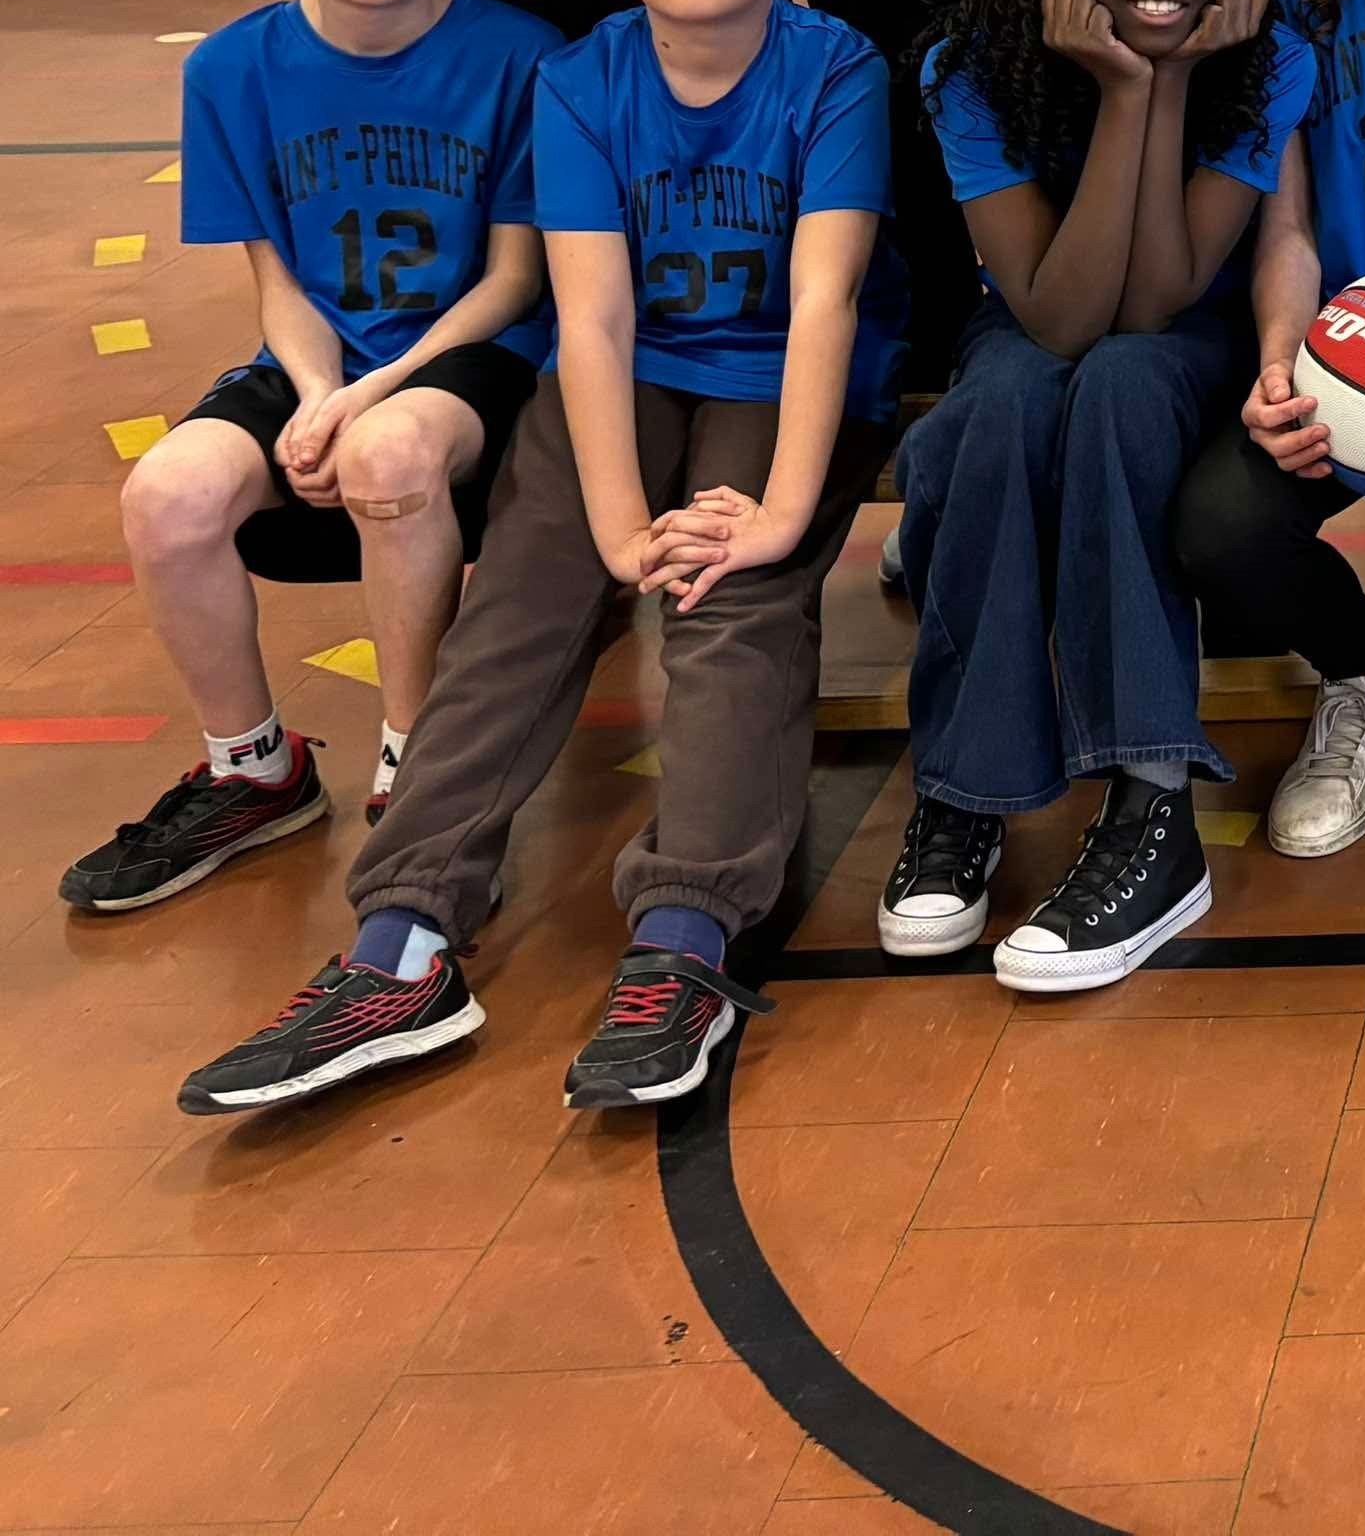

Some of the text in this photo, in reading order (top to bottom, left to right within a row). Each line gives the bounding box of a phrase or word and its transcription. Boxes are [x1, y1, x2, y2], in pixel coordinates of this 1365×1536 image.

[330, 208, 438, 312] 12
[645, 248, 768, 321] 27
[228, 724, 284, 767] FILA
